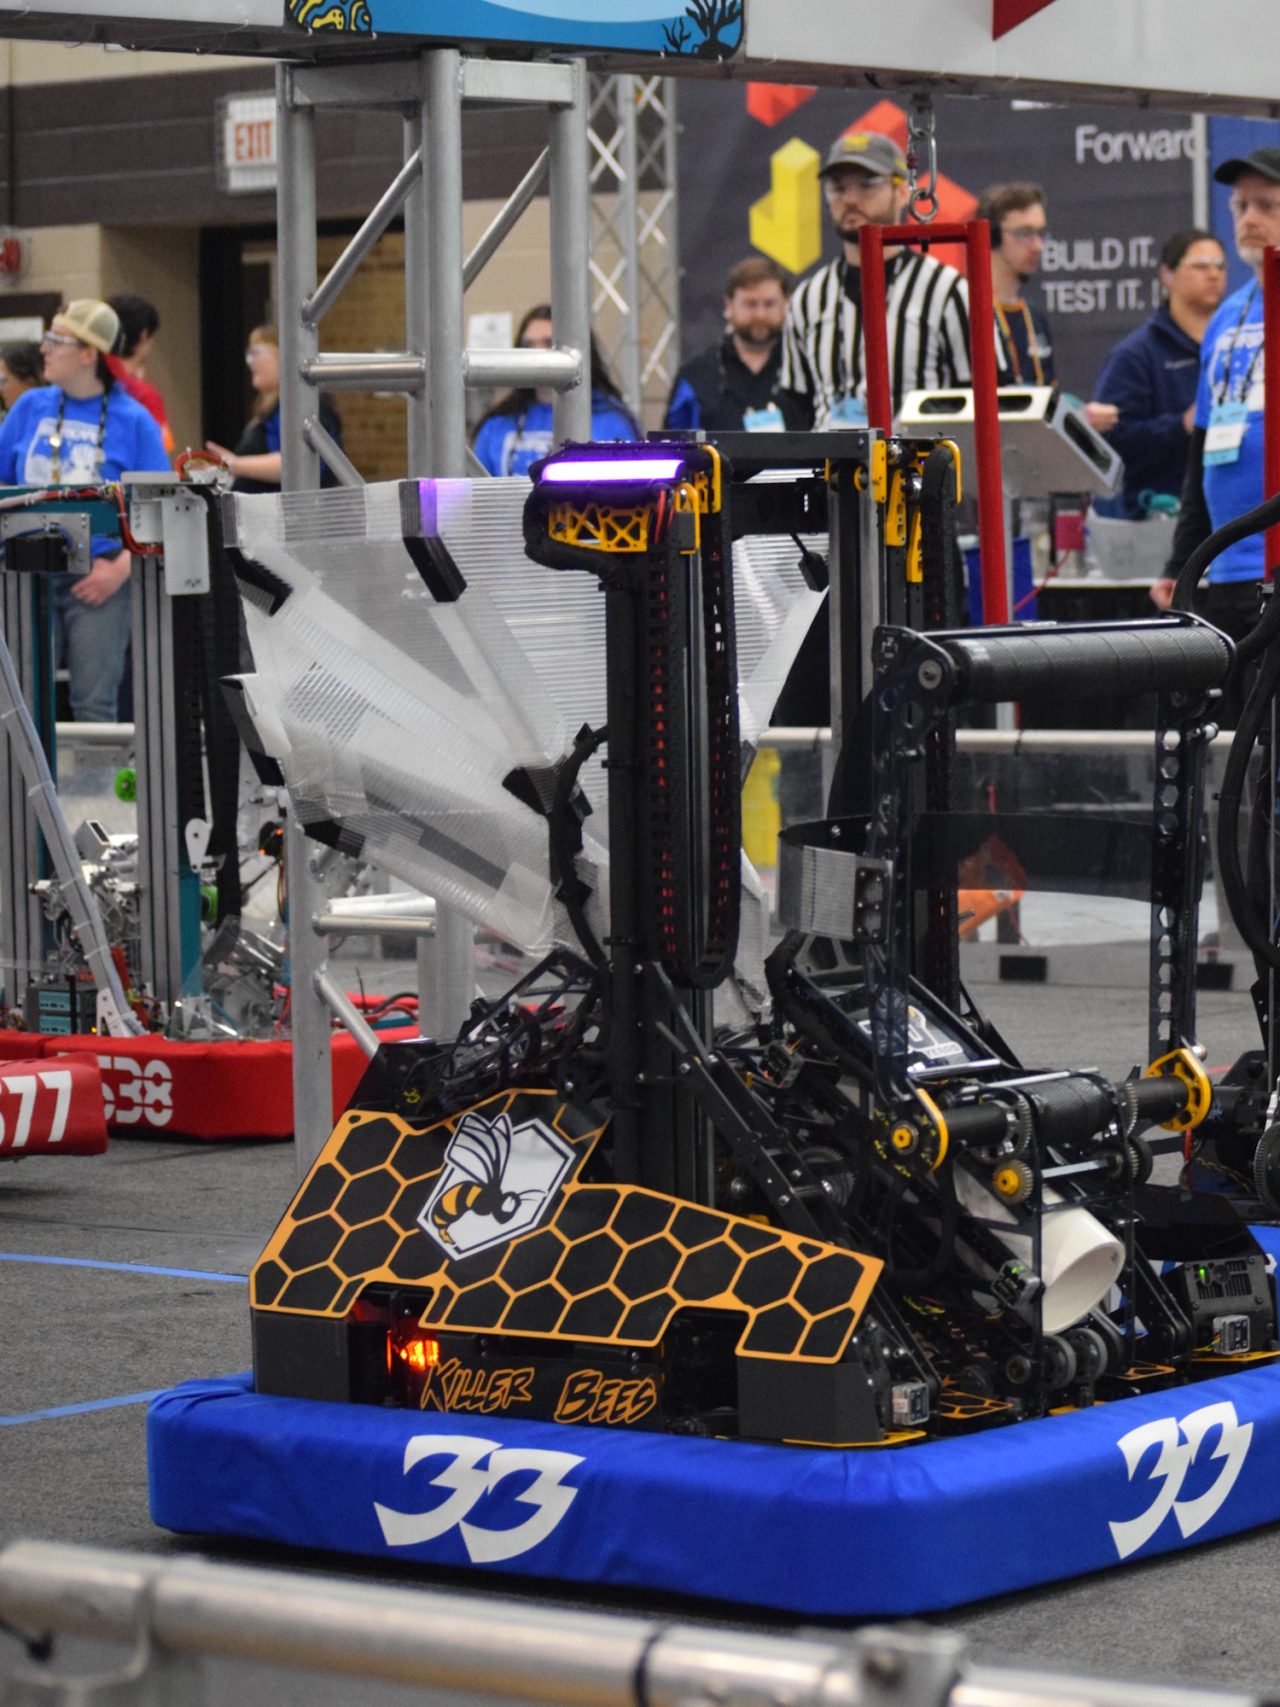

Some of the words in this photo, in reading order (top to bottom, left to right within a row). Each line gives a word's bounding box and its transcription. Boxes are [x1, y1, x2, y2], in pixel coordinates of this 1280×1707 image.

[234, 121, 273, 160] EXIT
[1041, 236, 1124, 272] BUILD
[1129, 236, 1158, 268] IT.
[1042, 280, 1111, 313] TEST
[1117, 279, 1146, 310] IT.
[373, 1434, 587, 1563] 33
[1108, 1400, 1254, 1560] 33
